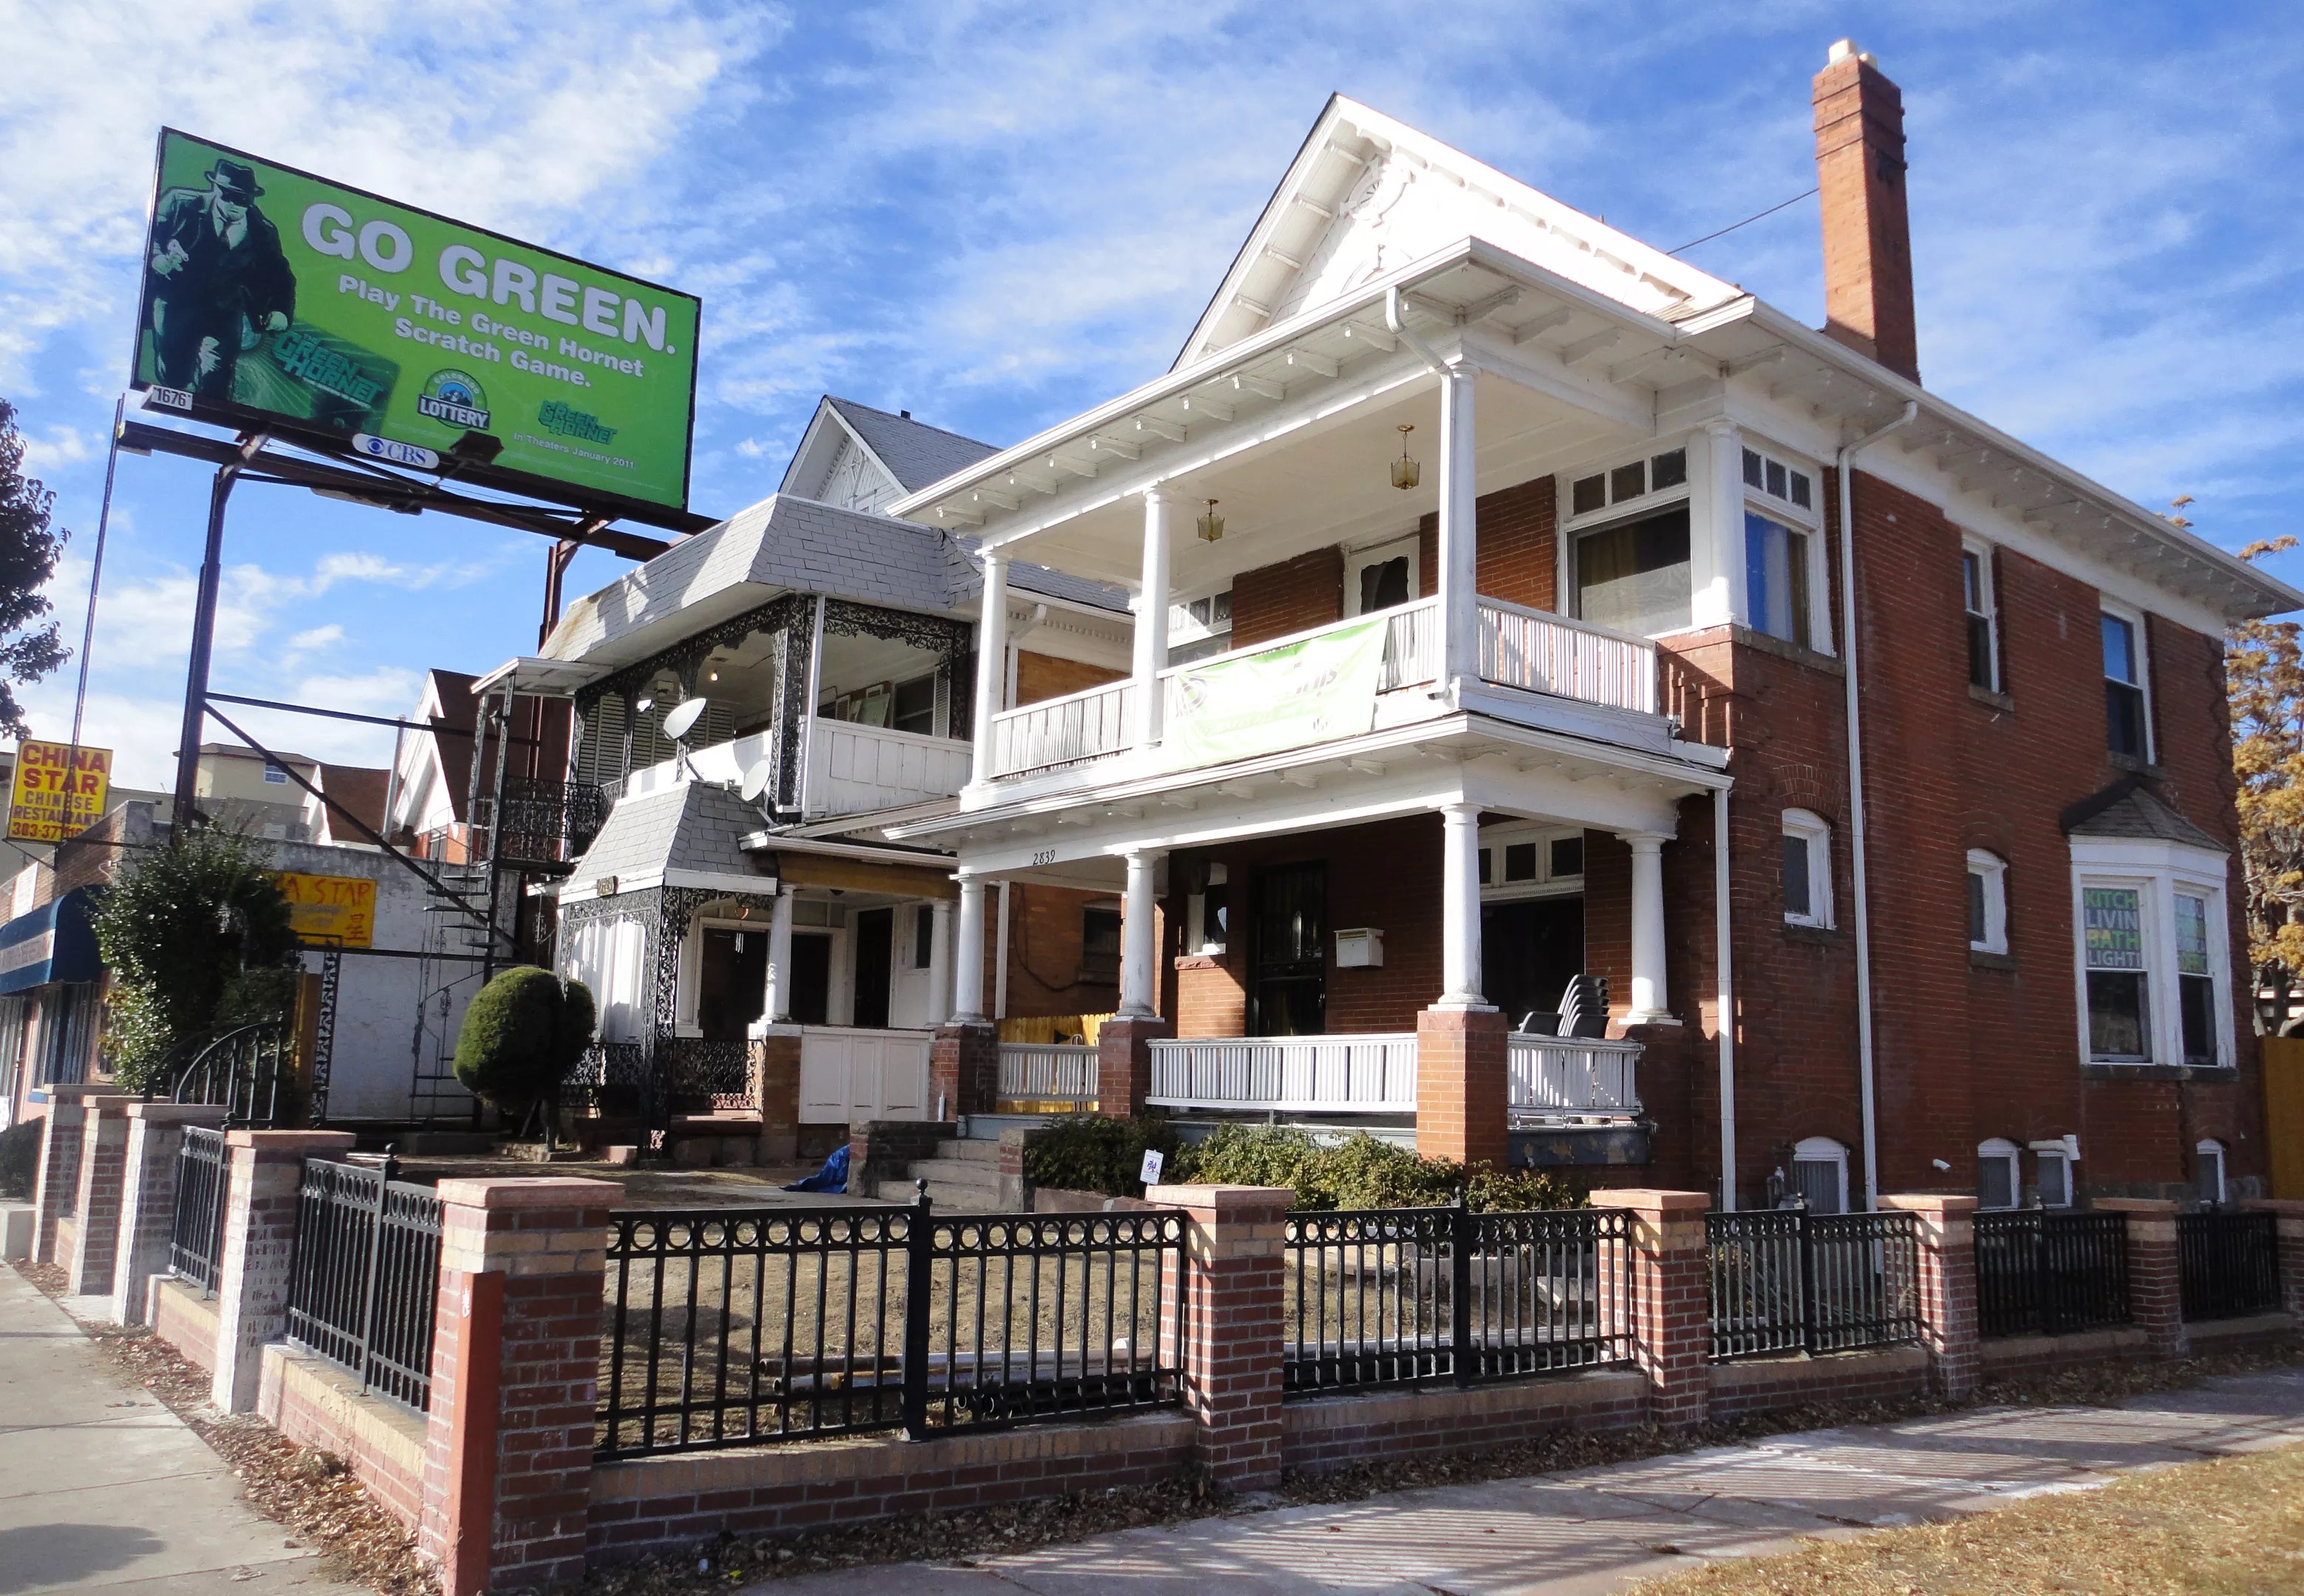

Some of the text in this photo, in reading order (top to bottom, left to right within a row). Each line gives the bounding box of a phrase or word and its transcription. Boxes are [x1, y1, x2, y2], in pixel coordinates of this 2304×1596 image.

[302, 203, 676, 355] GO GREEN.
[338, 274, 644, 378] Play The Green Hornet
[272, 331, 361, 379] GREEN
[395, 318, 591, 387] Scratch Game.
[273, 350, 385, 403] HORNET
[155, 387, 186, 406] 1676
[419, 398, 488, 429] LOTTERY
[538, 400, 599, 430] GREEN
[387, 442, 426, 465] CBS
[514, 432, 523, 442] In
[524, 434, 570, 453] Theaters
[573, 447, 611, 465] January
[22, 744, 106, 774] CHINA
[23, 768, 100, 796] STAR
[24, 791, 94, 811] CHINSE
[1032, 849, 1055, 866] 2839
